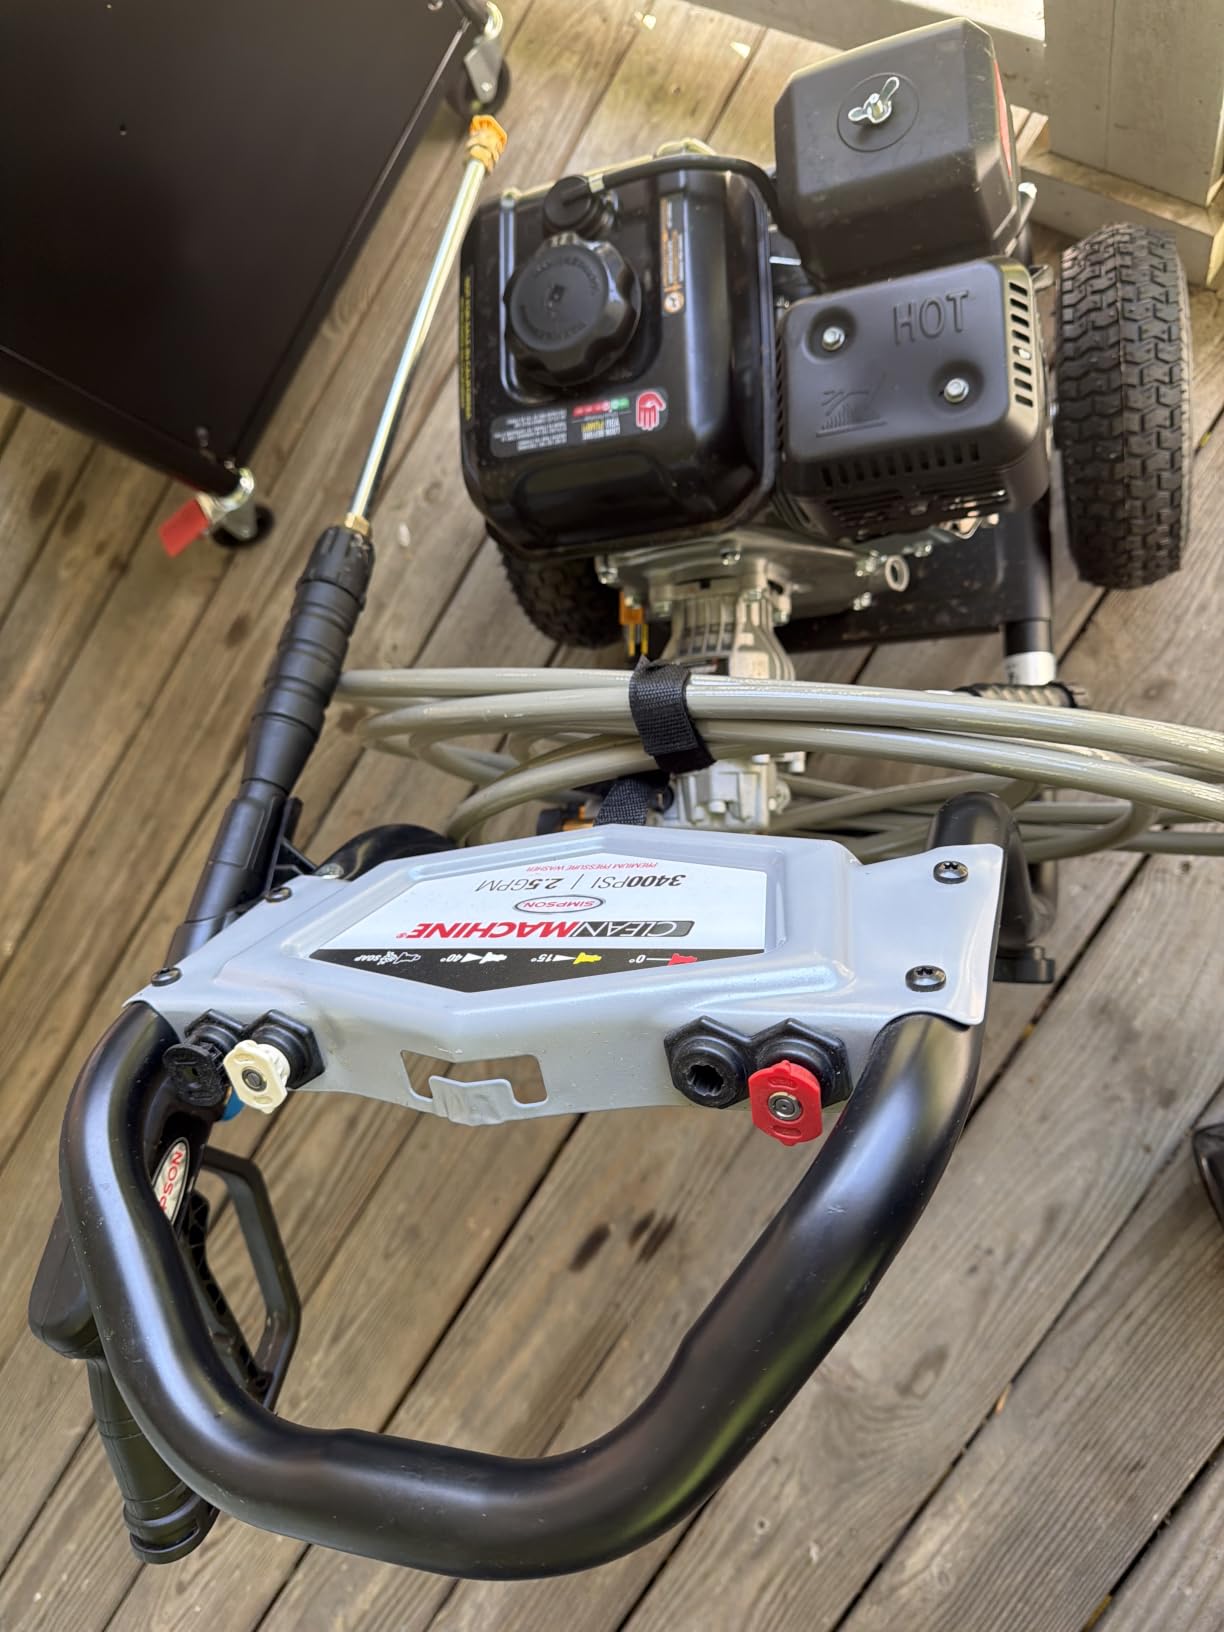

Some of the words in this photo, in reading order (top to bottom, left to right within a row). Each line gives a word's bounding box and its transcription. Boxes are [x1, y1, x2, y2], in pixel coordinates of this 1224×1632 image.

[892, 289, 969, 347] HOT
[475, 878, 565, 892] 2.5GPM
[591, 874, 686, 889] 3400PSI
[523, 900, 596, 908] SIMPSON
[353, 953, 381, 962] SOAP
[159, 1151, 183, 1211] PSON
